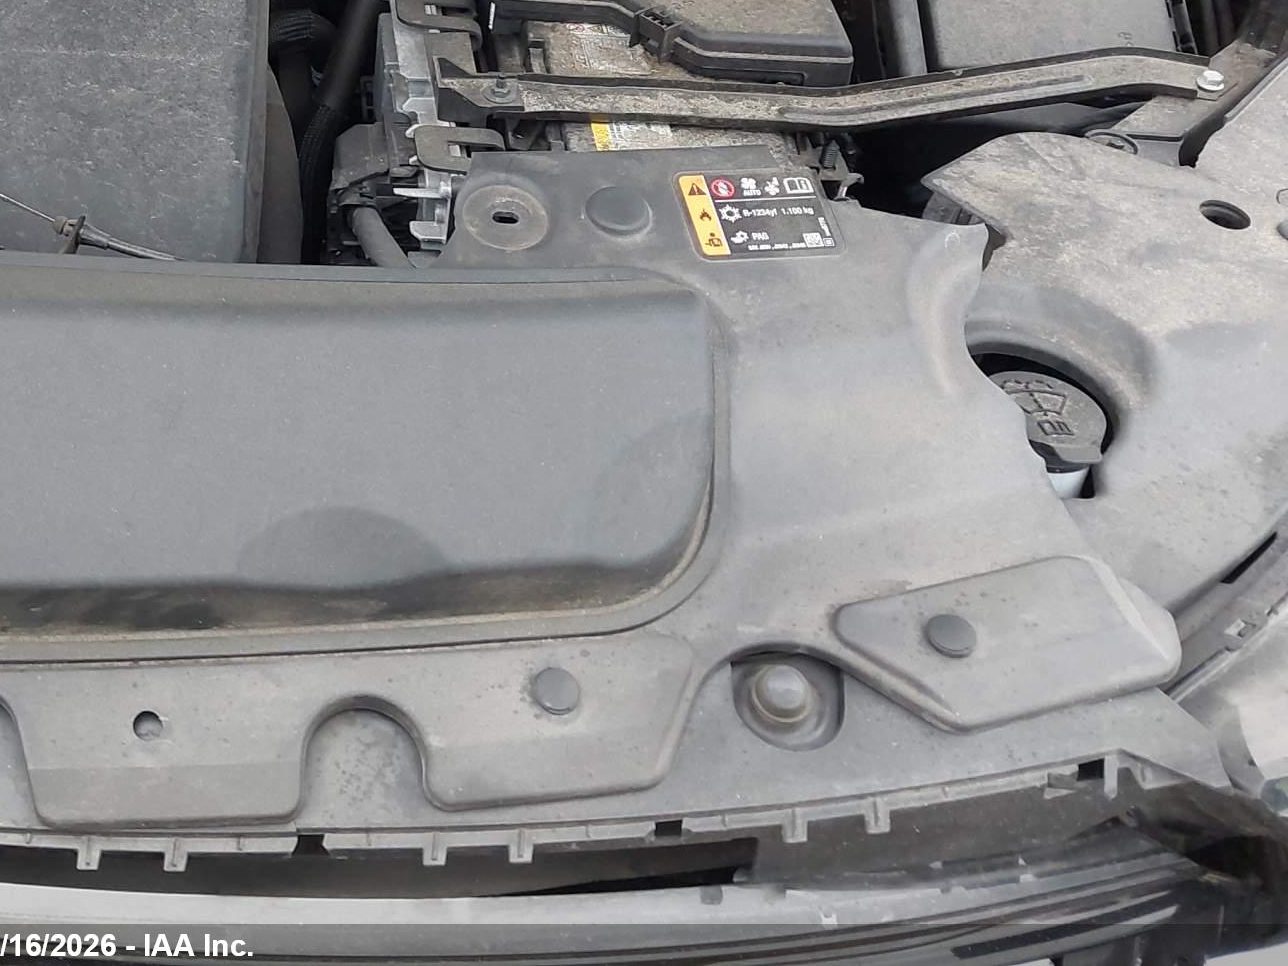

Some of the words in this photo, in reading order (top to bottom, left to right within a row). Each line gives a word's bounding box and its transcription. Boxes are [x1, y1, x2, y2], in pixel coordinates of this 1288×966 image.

[743, 189, 762, 197] AUTO
[742, 208, 778, 217] R-1234yf
[780, 207, 802, 215] 1.100
[803, 206, 815, 215] kg
[752, 231, 770, 241] PAG
